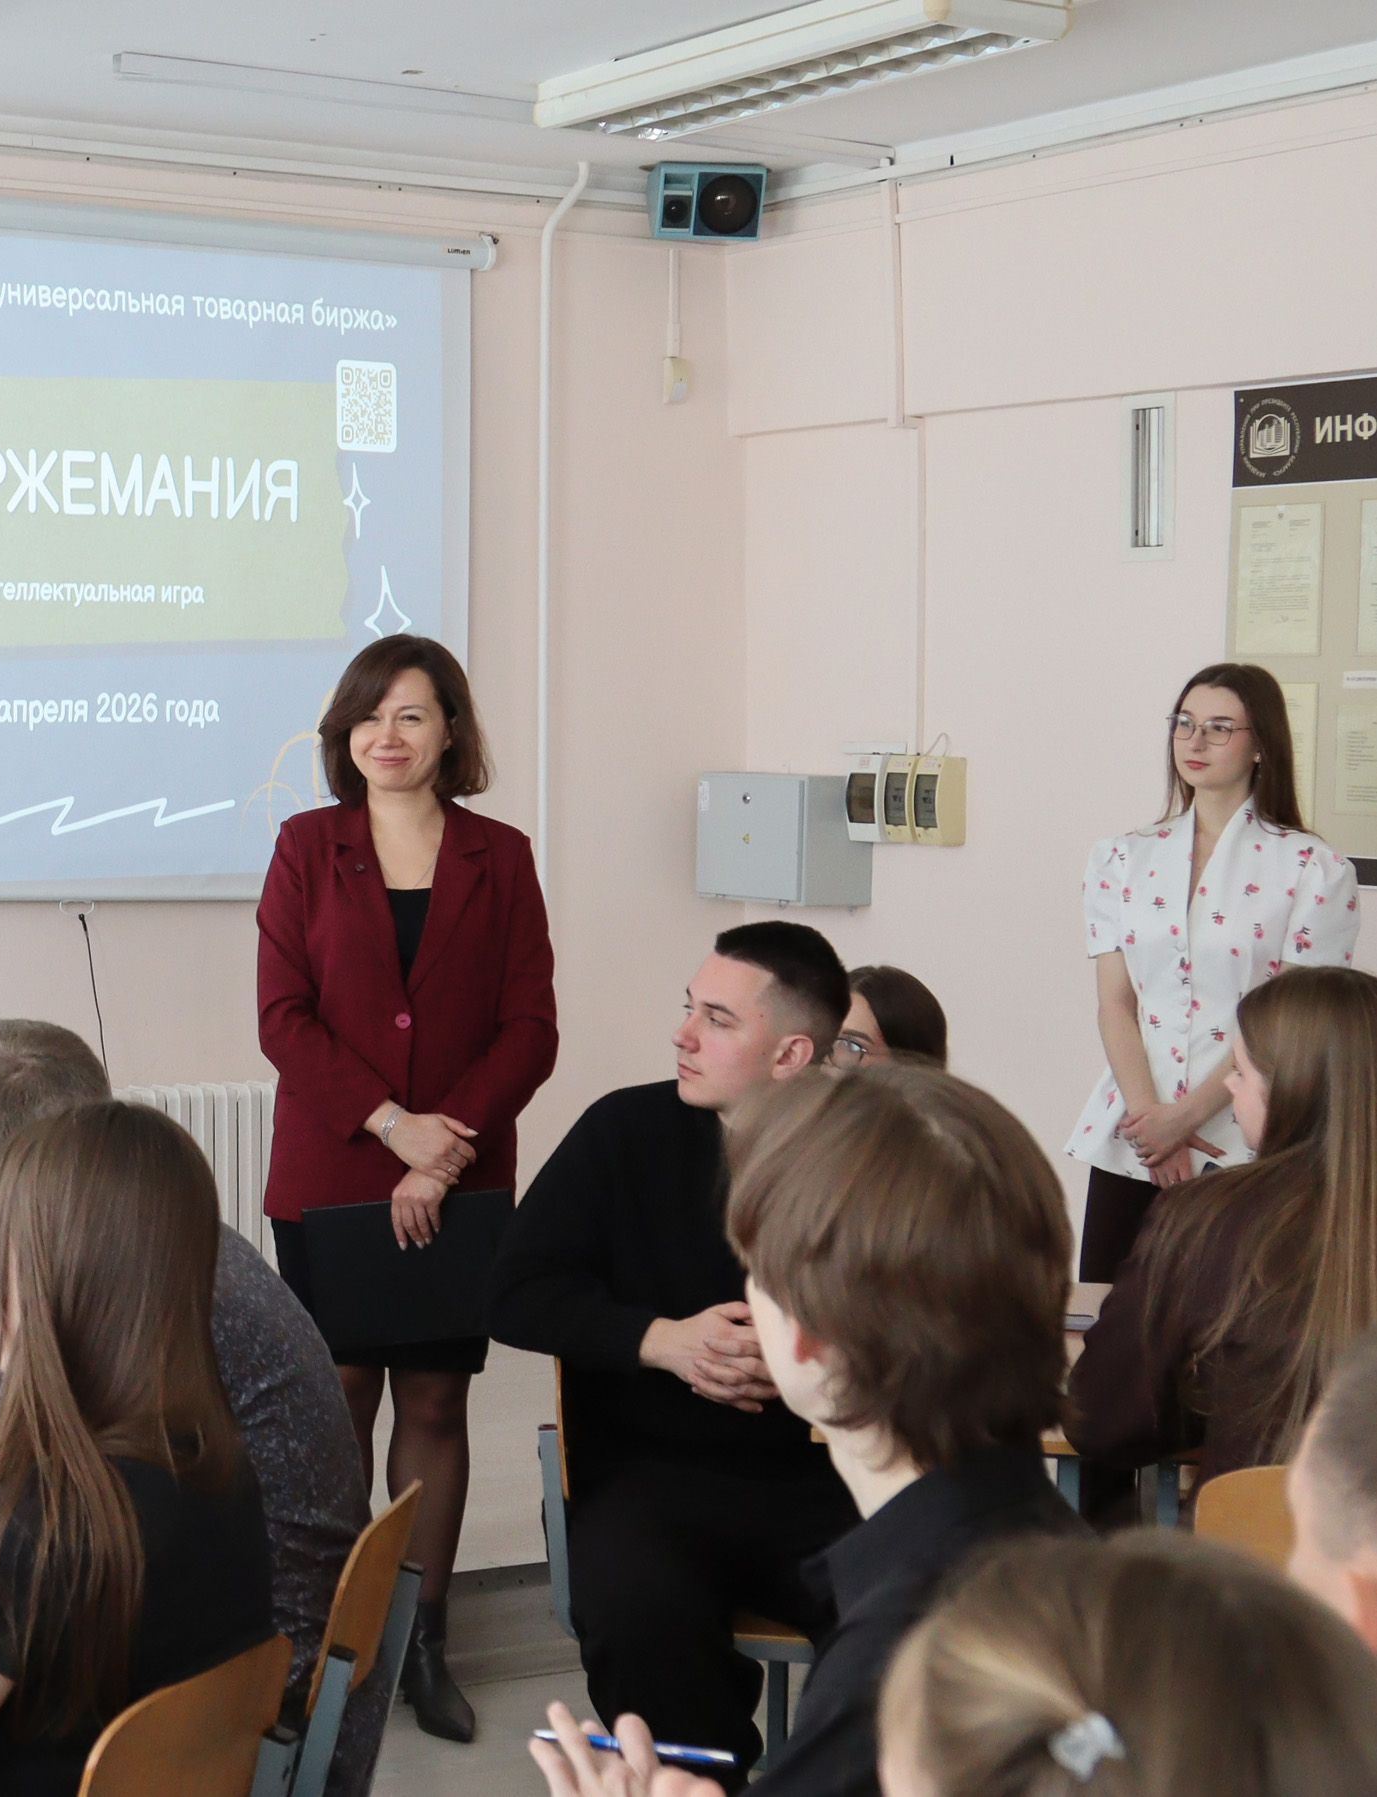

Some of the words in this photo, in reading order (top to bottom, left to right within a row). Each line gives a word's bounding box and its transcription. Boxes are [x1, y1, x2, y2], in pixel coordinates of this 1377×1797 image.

[192, 296, 304, 328] товарная
[312, 298, 397, 335] биржа»
[162, 586, 205, 609] игра
[96, 693, 158, 722] 2026
[166, 700, 219, 729] года
